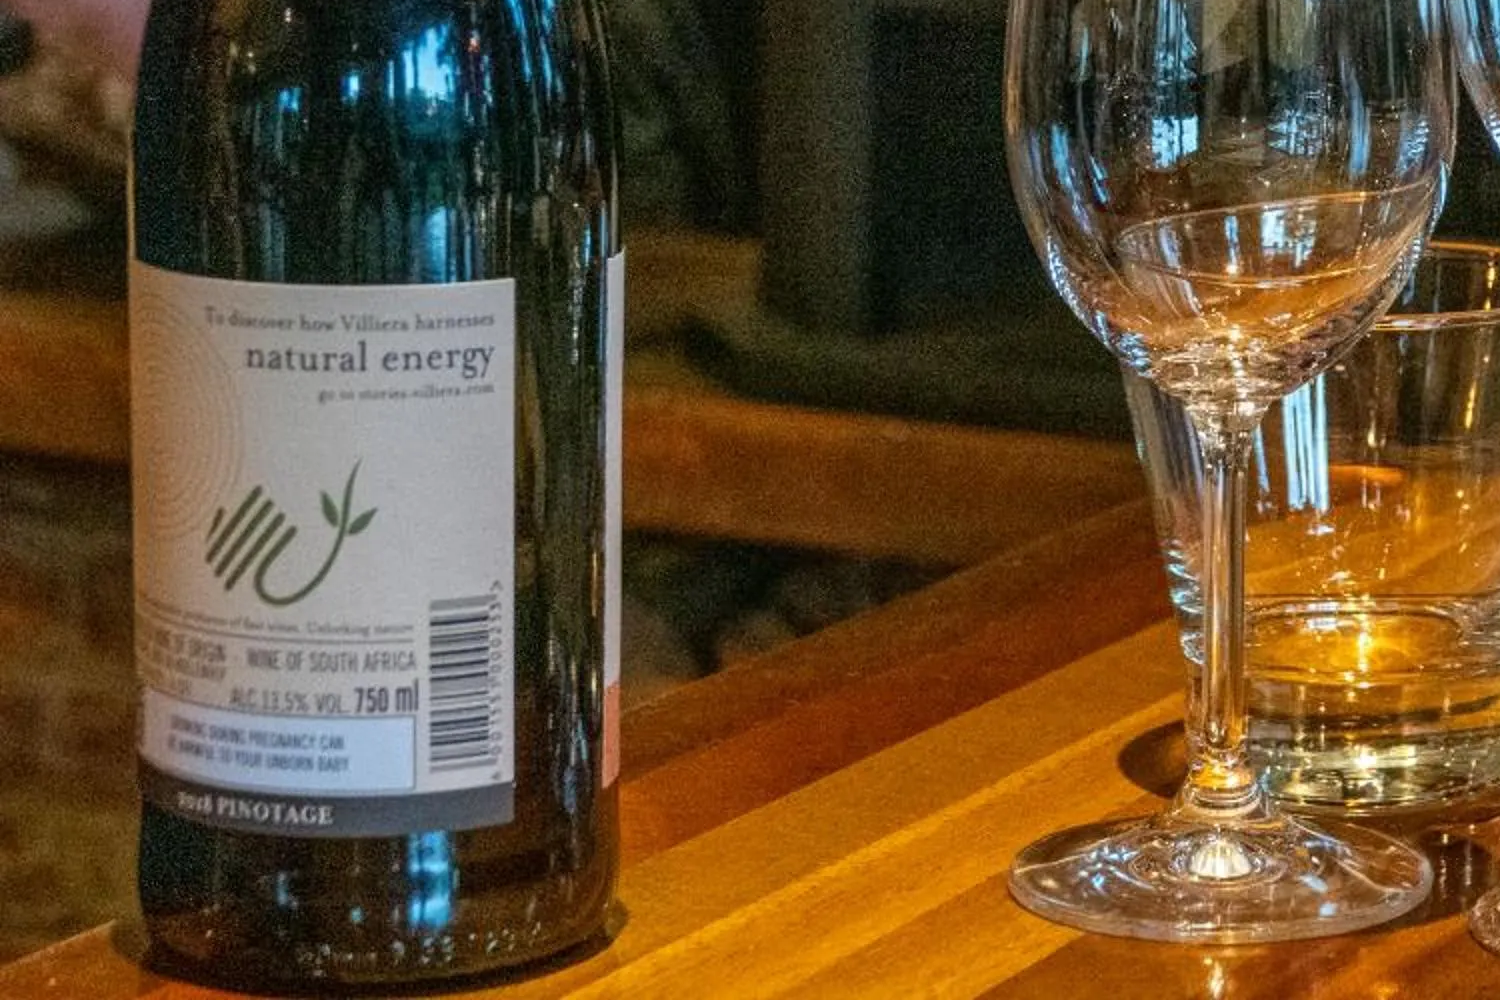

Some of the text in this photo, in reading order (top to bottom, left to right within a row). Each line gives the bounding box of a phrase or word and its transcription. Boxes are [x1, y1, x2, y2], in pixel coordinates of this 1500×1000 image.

[204, 305, 225, 326] To
[228, 308, 295, 331] discover
[301, 314, 335, 332] how
[415, 312, 495, 332] harnesses
[246, 340, 495, 380] natural energy
[246, 648, 280, 671] WINE
[285, 651, 304, 672] OF
[308, 651, 356, 674] SOUTH
[362, 649, 418, 673] AFRICA
[354, 687, 390, 714] 750
[395, 680, 420, 713] ml
[216, 796, 335, 827] PINOTAGE
